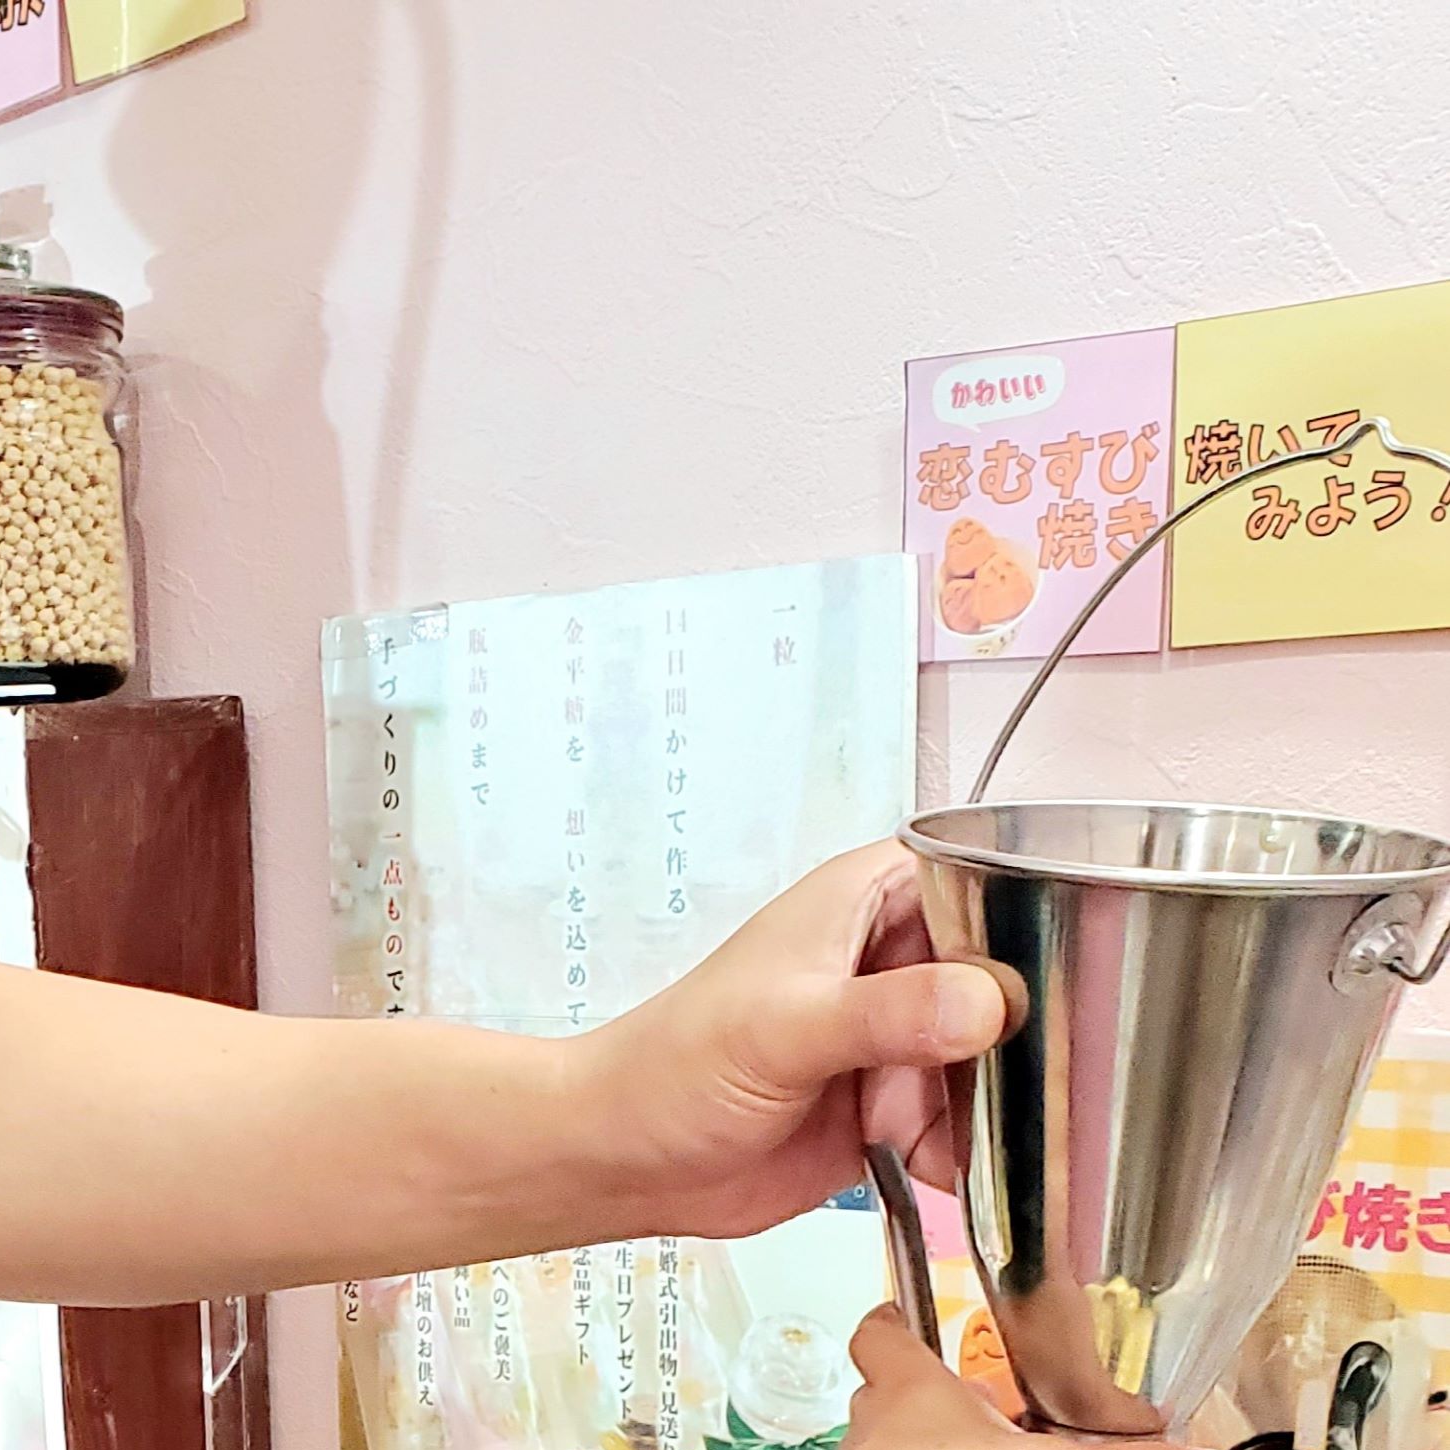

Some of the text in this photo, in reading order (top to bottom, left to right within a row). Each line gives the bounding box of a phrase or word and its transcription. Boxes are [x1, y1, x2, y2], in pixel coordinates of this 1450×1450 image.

[951, 373, 1046, 410] かわいい
[916, 420, 1161, 512] 恋むすび
[1184, 408, 1361, 485] 焼いて
[1037, 496, 1159, 572] 焼き
[772, 603, 798, 667] 一粒
[468, 627, 490, 806] 瓶詰めまで
[563, 616, 588, 1025] 金平糖を 想いを込めて
[614, 1241, 634, 1419] 生日プレゼント
